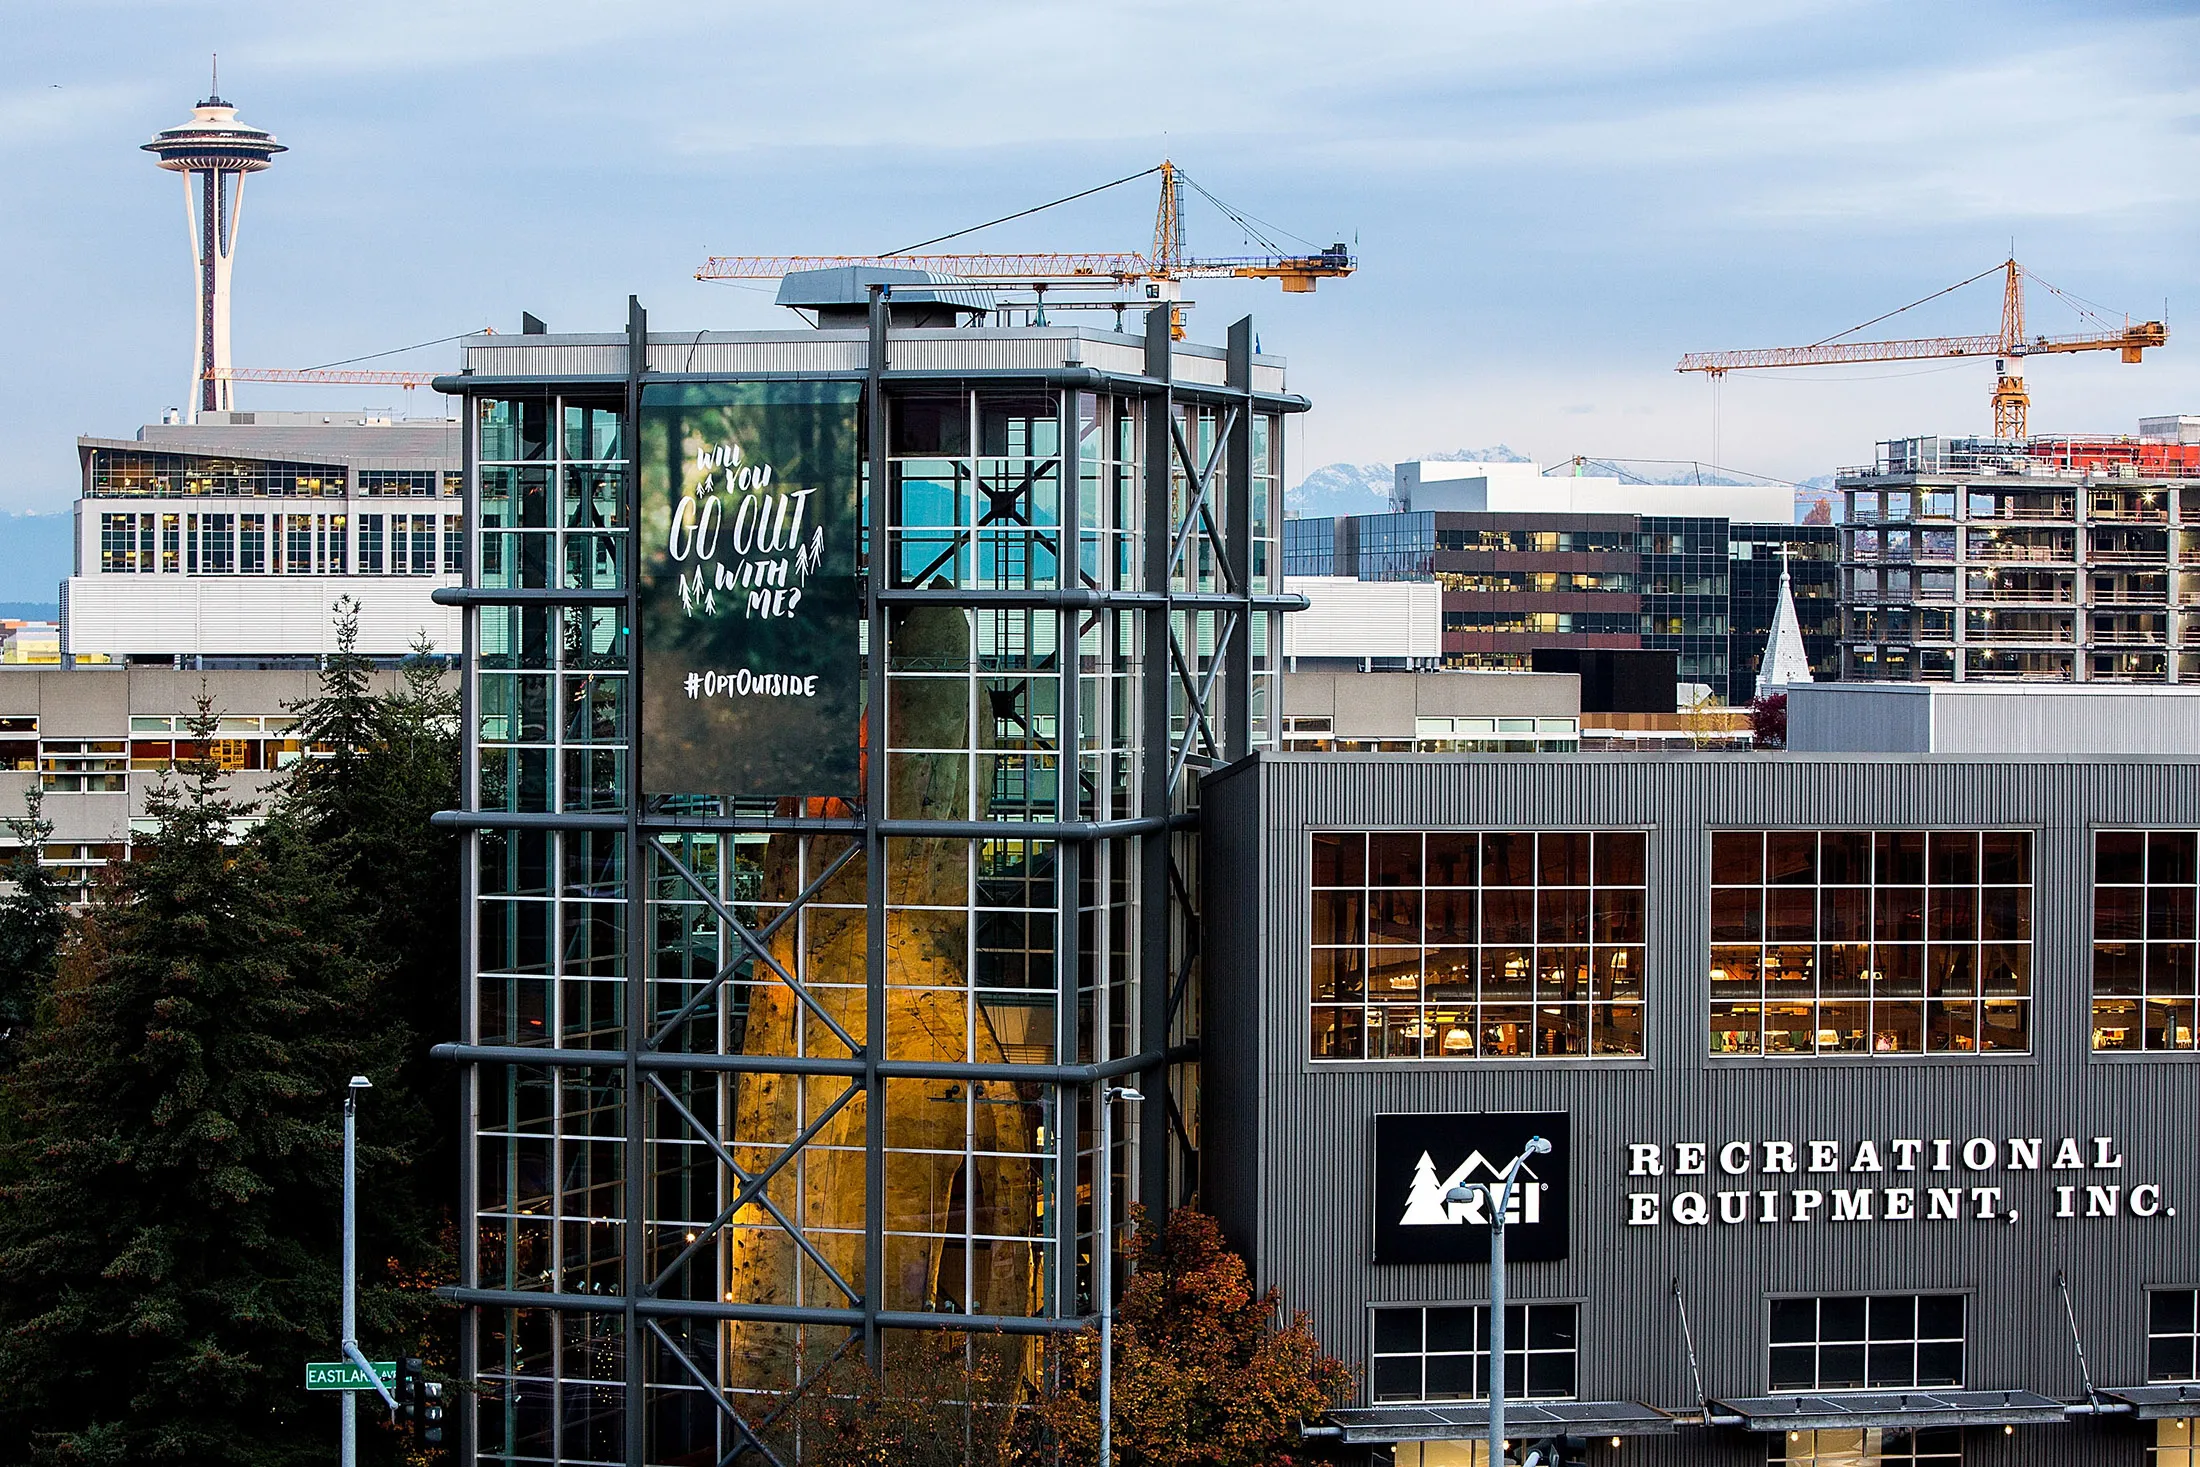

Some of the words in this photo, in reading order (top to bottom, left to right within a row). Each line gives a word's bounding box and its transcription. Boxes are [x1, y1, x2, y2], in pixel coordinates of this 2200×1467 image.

[697, 443, 742, 471] WILL
[725, 463, 772, 494] YOU
[669, 495, 722, 561] GO
[733, 488, 818, 555] OUT
[714, 559, 789, 591] WITH
[746, 587, 802, 619] ME?
[1628, 1137, 2123, 1176] RECREATIONAL
[1628, 1187, 2019, 1225] EQUIPMENT,
[2056, 1184, 2177, 1219] INC.
[308, 1369, 377, 1383] EASTLAK
